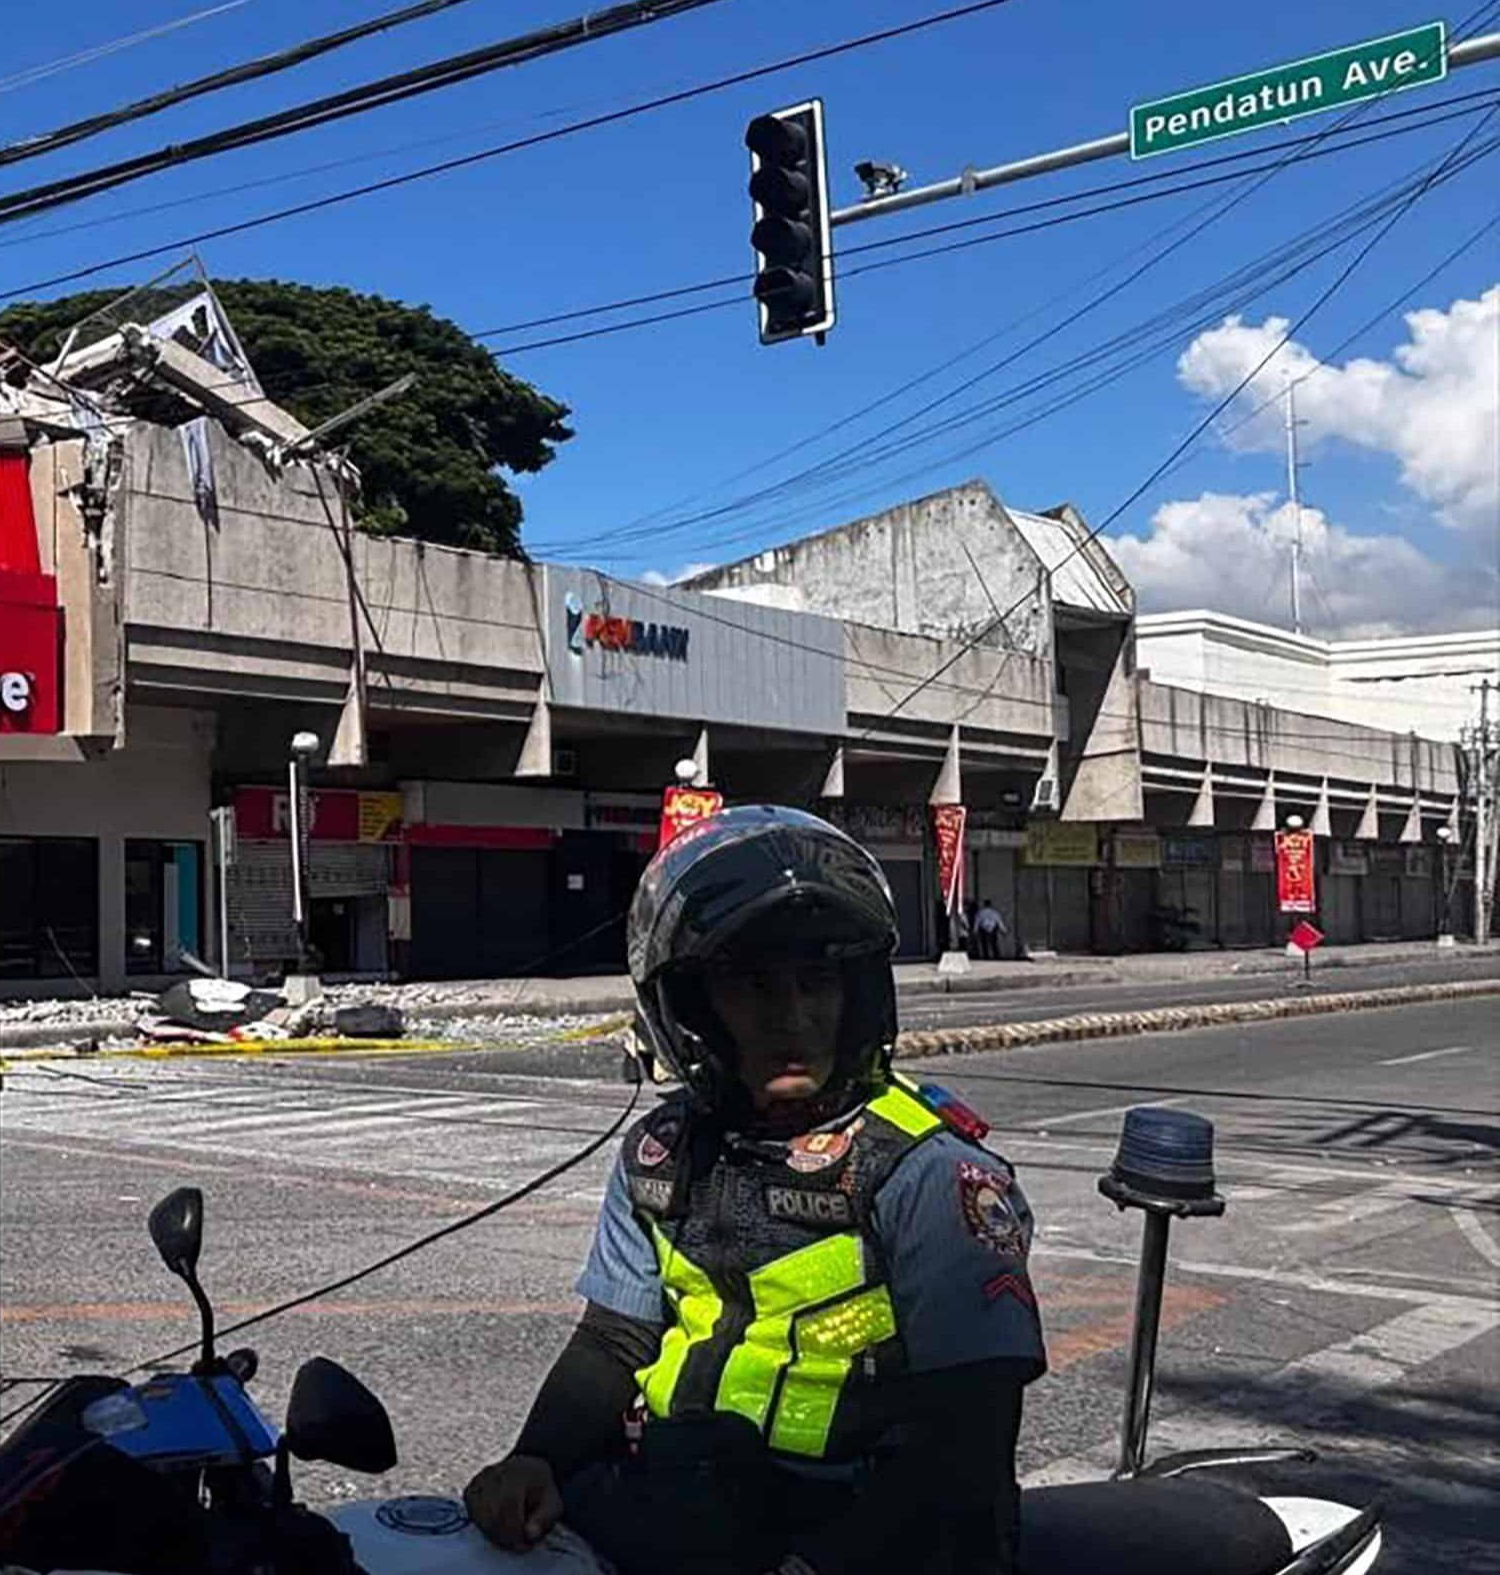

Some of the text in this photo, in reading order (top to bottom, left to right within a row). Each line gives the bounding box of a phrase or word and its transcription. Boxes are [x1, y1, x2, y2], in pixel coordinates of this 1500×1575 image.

[1145, 49, 1429, 142] Pendatun Ave.
[769, 1186, 849, 1220] POLICE
